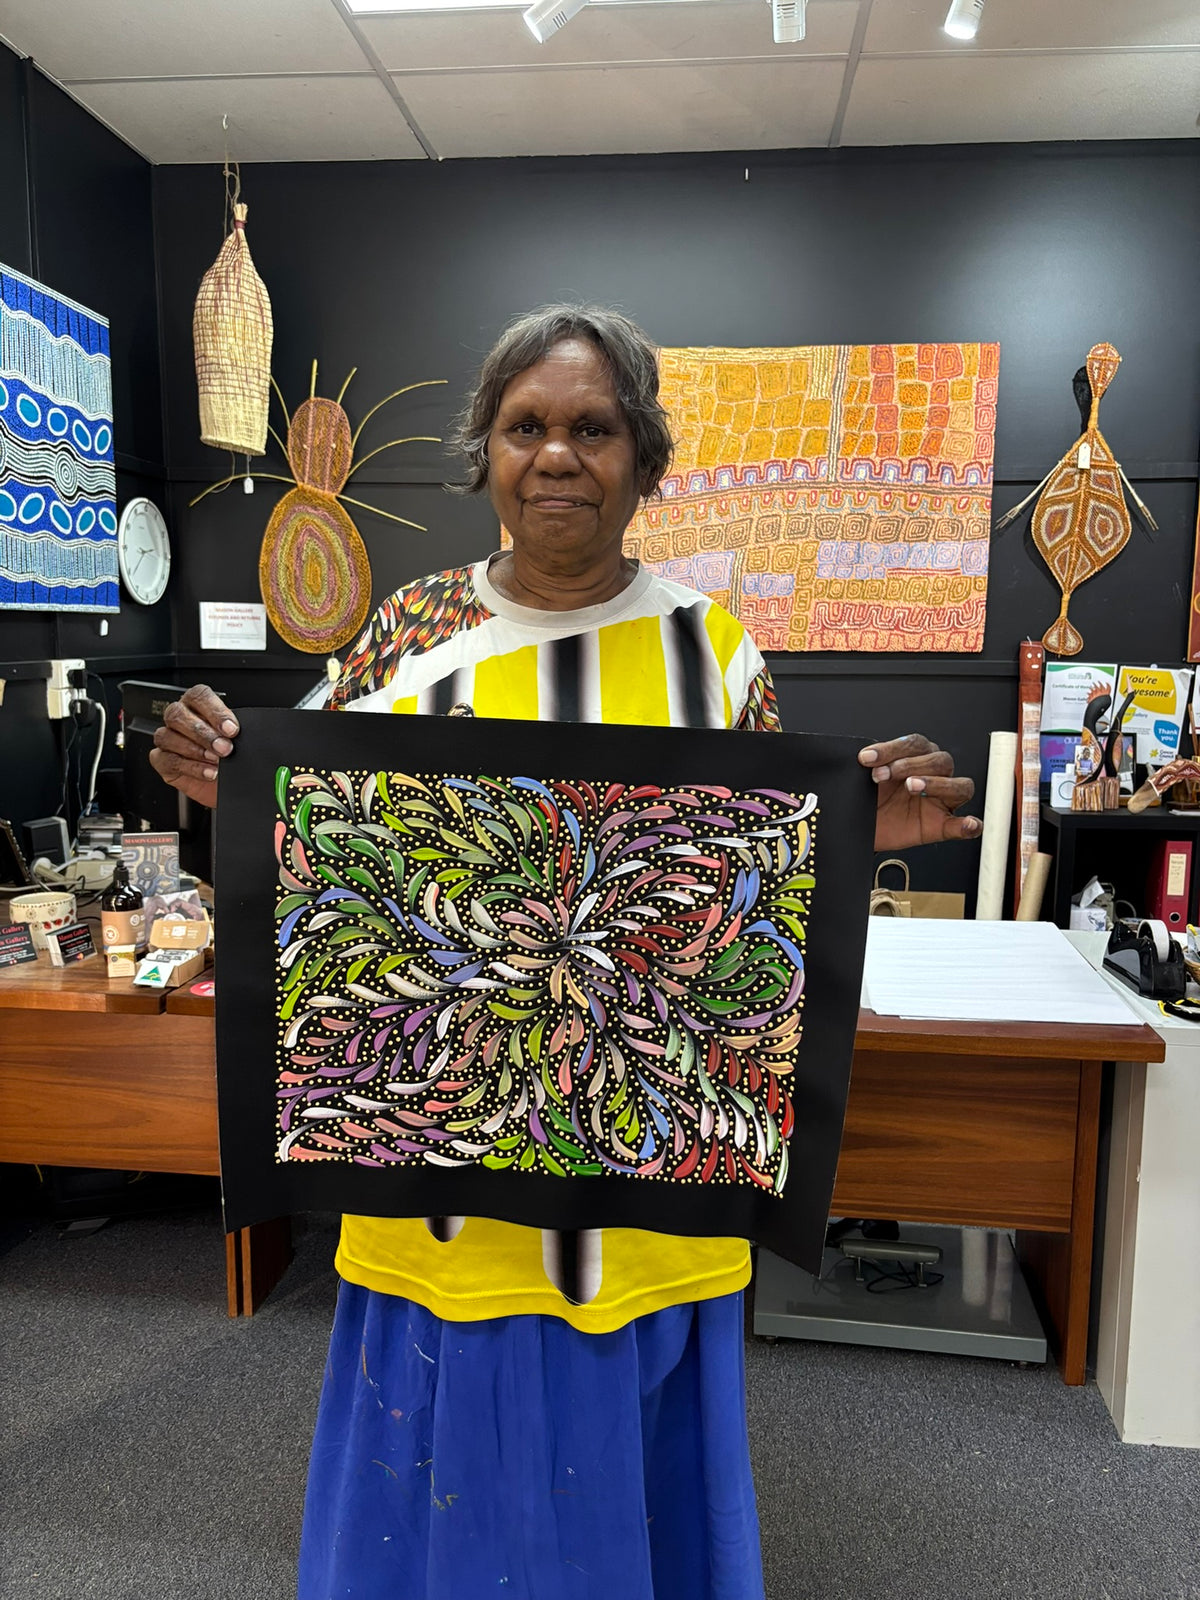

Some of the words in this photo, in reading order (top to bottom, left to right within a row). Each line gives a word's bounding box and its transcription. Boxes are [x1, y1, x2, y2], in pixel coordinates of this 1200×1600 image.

[1158, 727, 1178, 736] Thank
[1, 925, 25, 935] Gallery
[4, 936, 28, 945] Gallery
